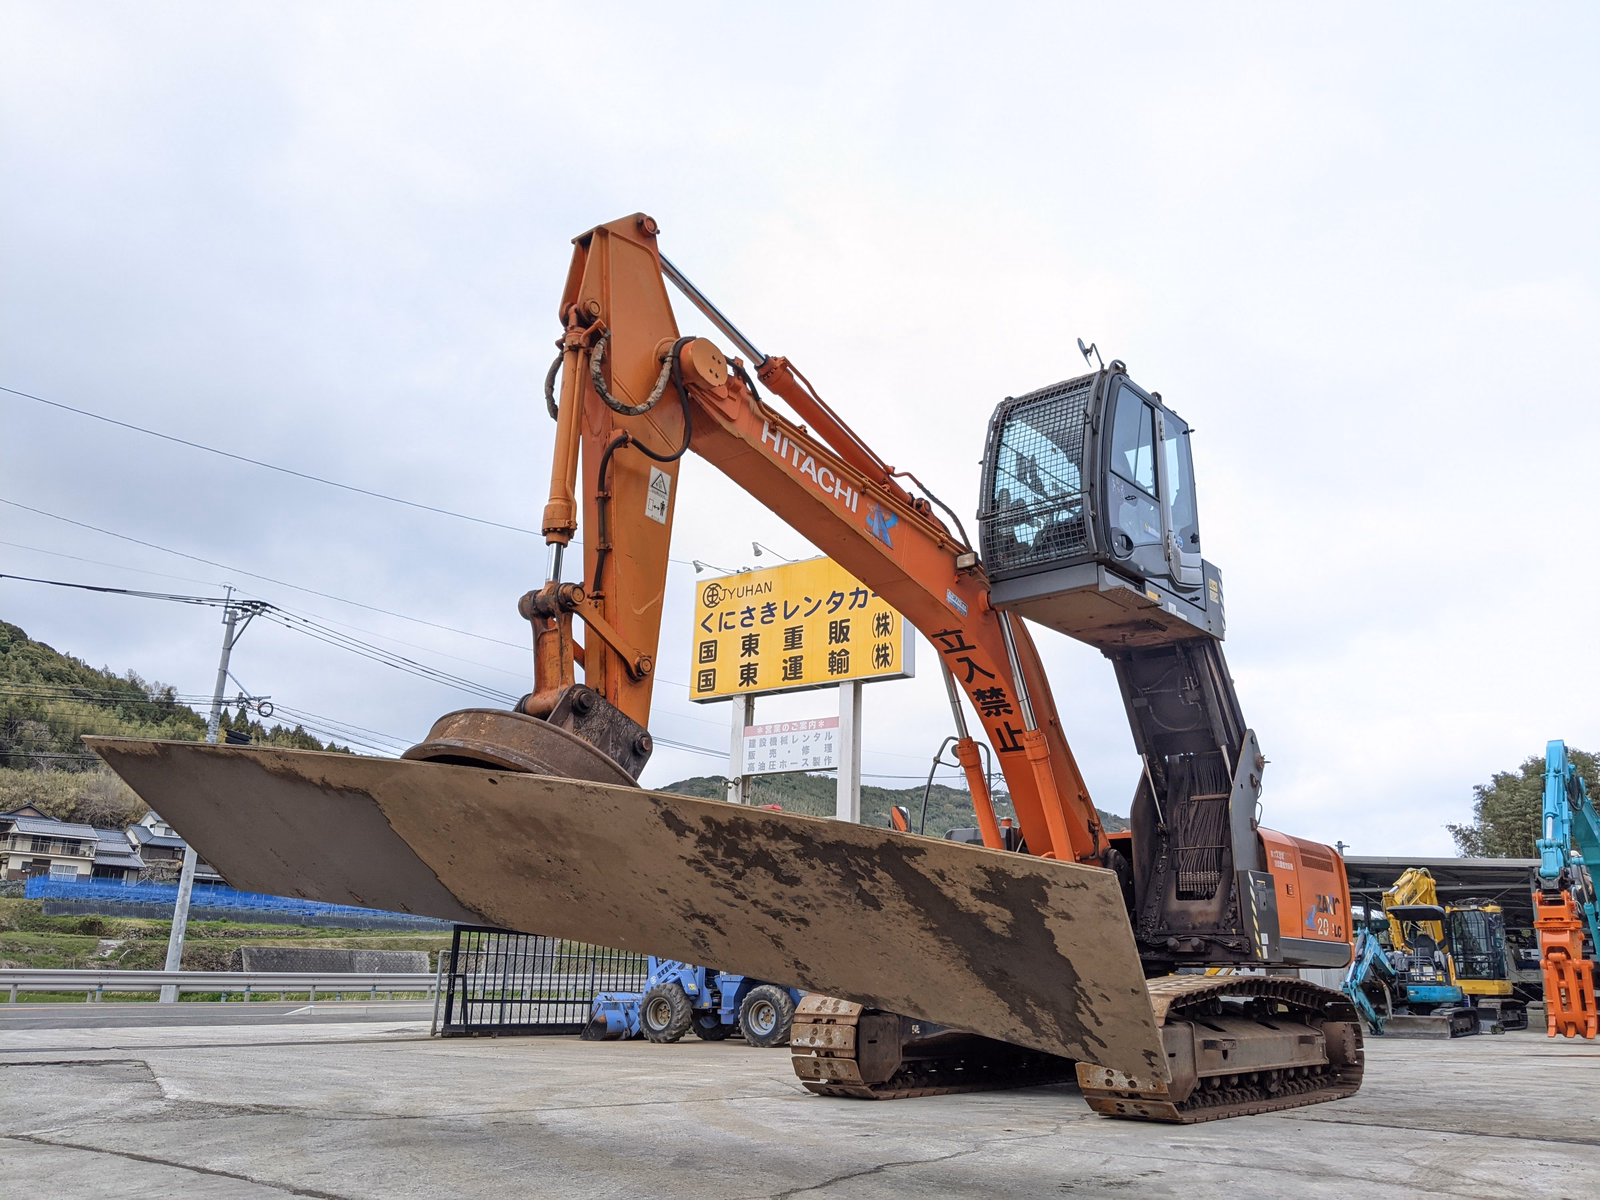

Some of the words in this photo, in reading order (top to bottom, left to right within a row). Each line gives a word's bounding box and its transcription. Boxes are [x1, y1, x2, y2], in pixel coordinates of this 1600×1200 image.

[761, 421, 858, 513] HITACHI
[719, 581, 772, 601] JYUHAN
[931, 628, 1026, 753] 立入禁止
[748, 731, 833, 749] 建設機械レンタル
[747, 756, 833, 772] 高油圧ホース製作
